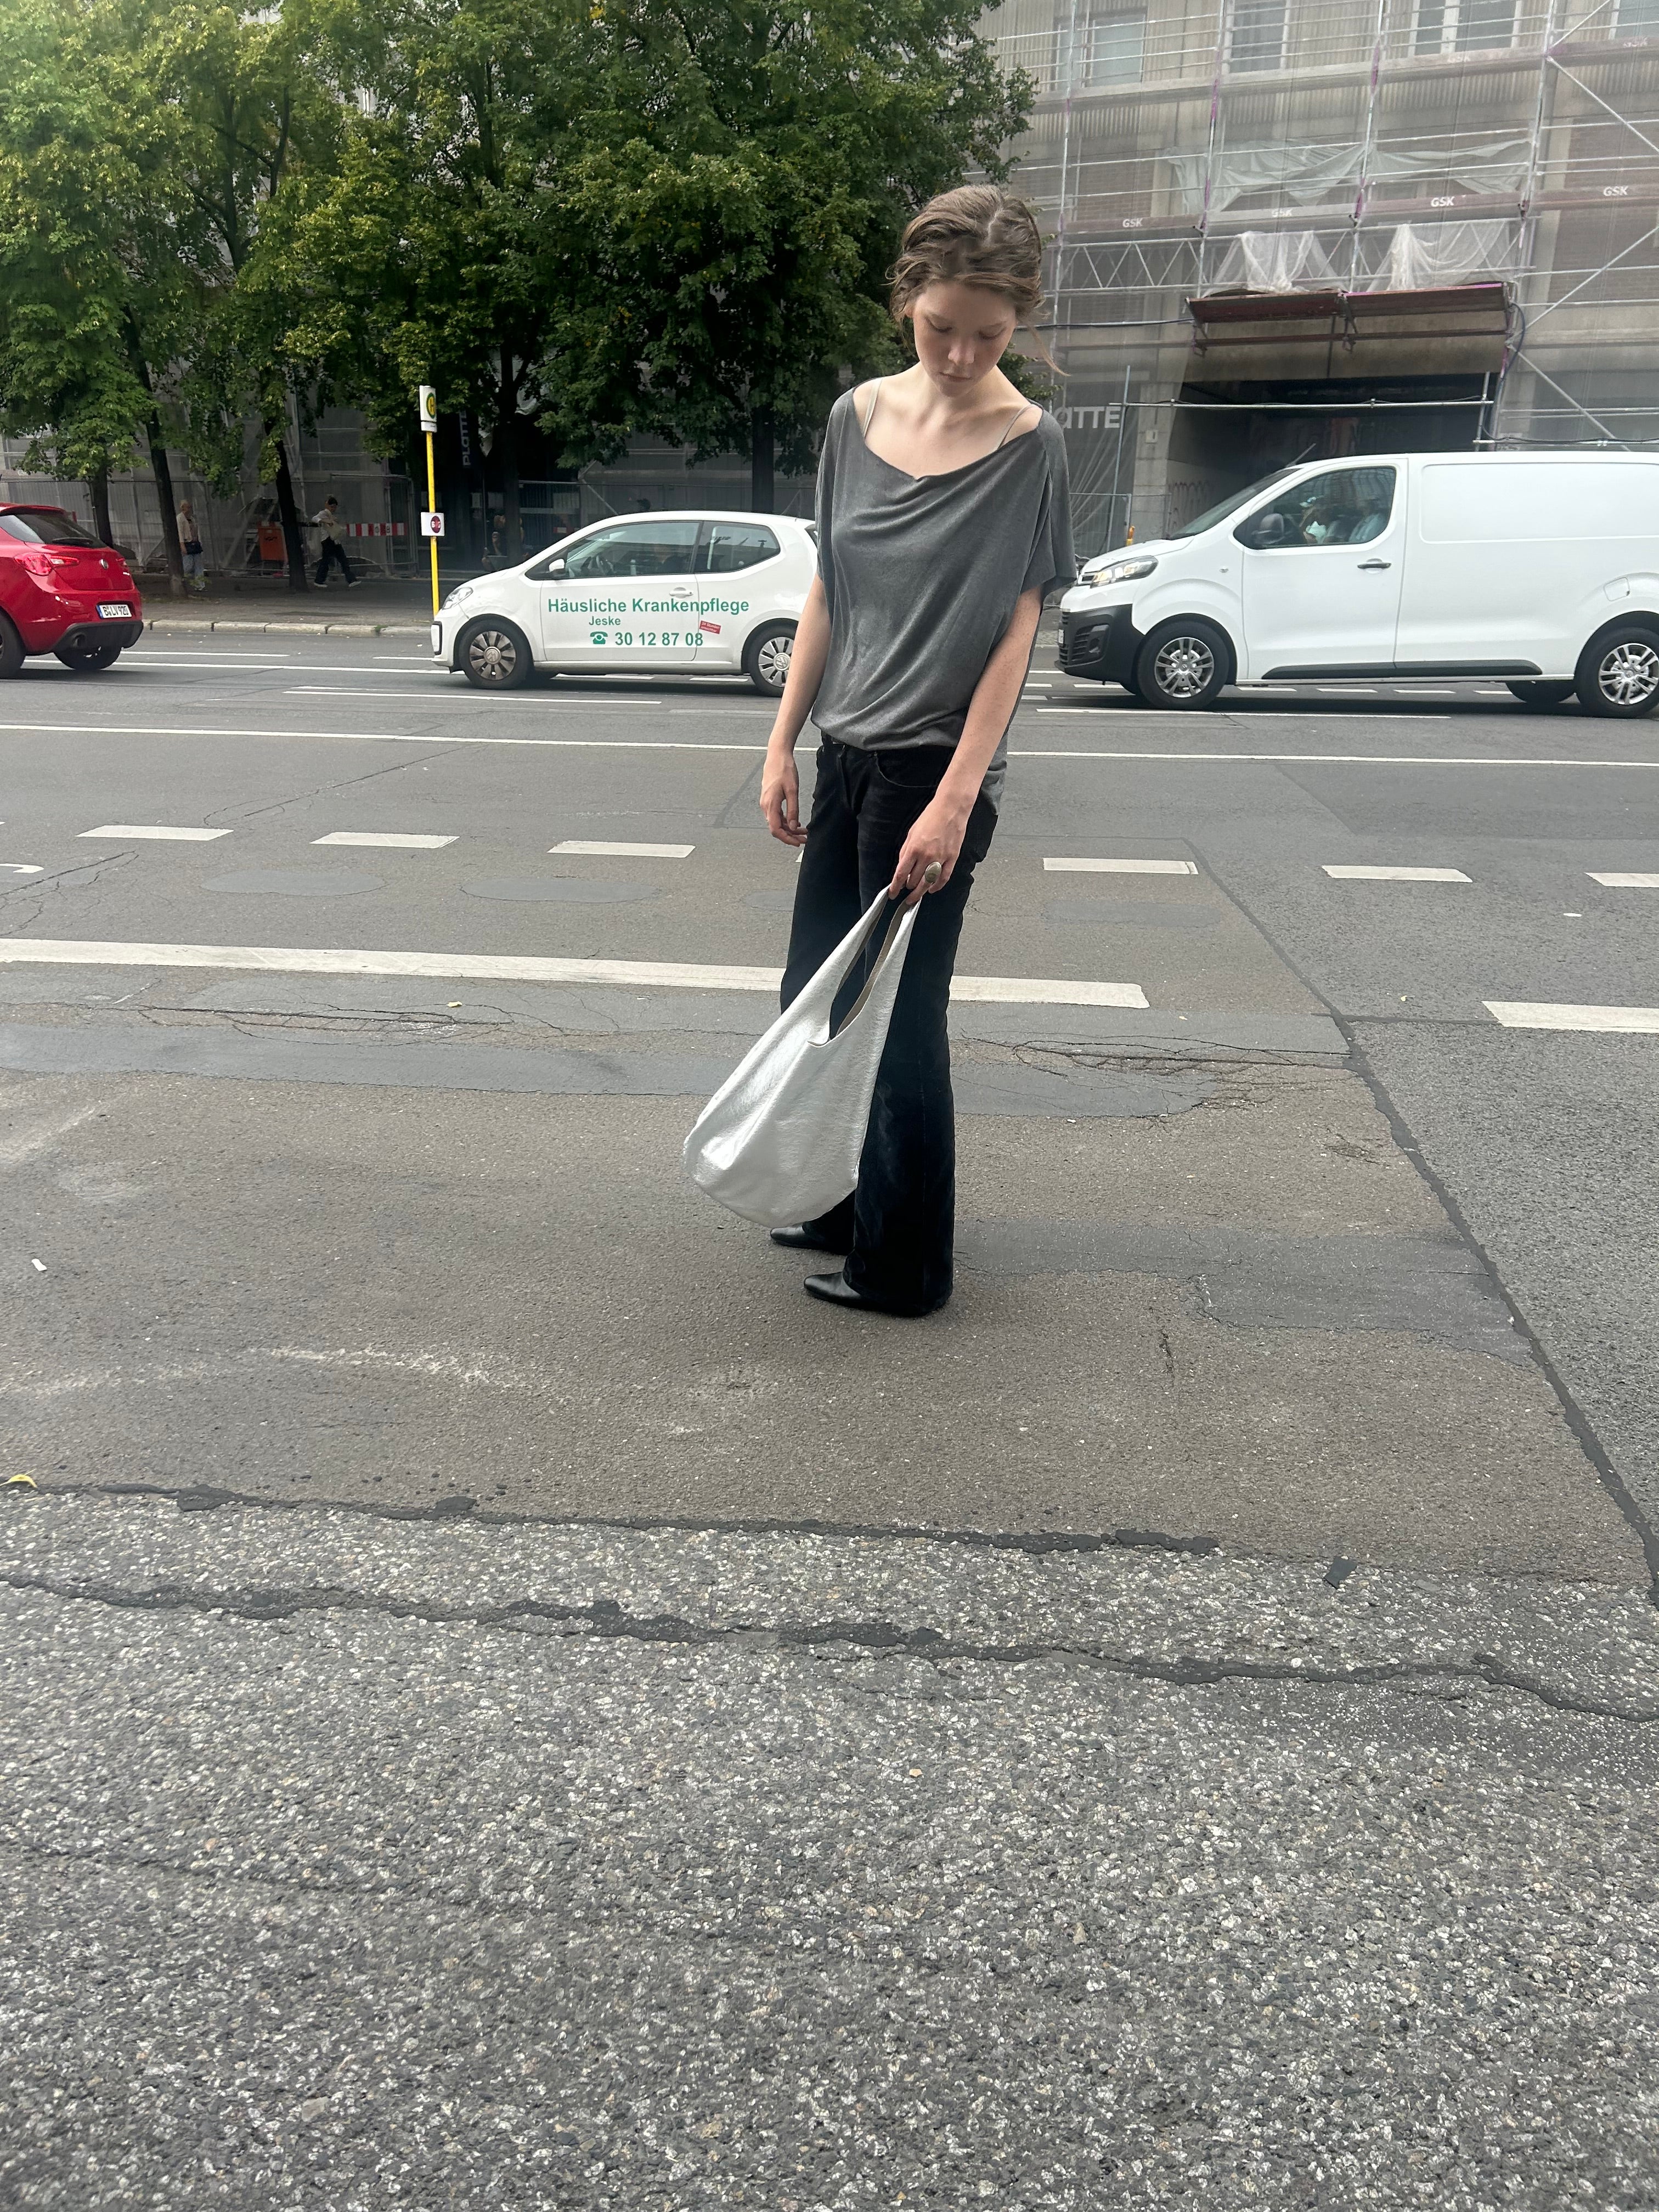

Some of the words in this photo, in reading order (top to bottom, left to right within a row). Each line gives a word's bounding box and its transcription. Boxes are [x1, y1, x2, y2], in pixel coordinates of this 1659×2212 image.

[1603, 185, 1629, 196] GSK
[1430, 196, 1455, 207] GSK
[1122, 218, 1143, 228] GSK
[1053, 405, 1121, 428] ATTE
[548, 599, 627, 612] Häusliche
[633, 598, 749, 615] Krankenpflege
[589, 616, 621, 625] Jeske
[615, 632, 633, 646] 30
[639, 632, 657, 646] 12
[662, 632, 680, 646] 87
[685, 632, 703, 646] 08
